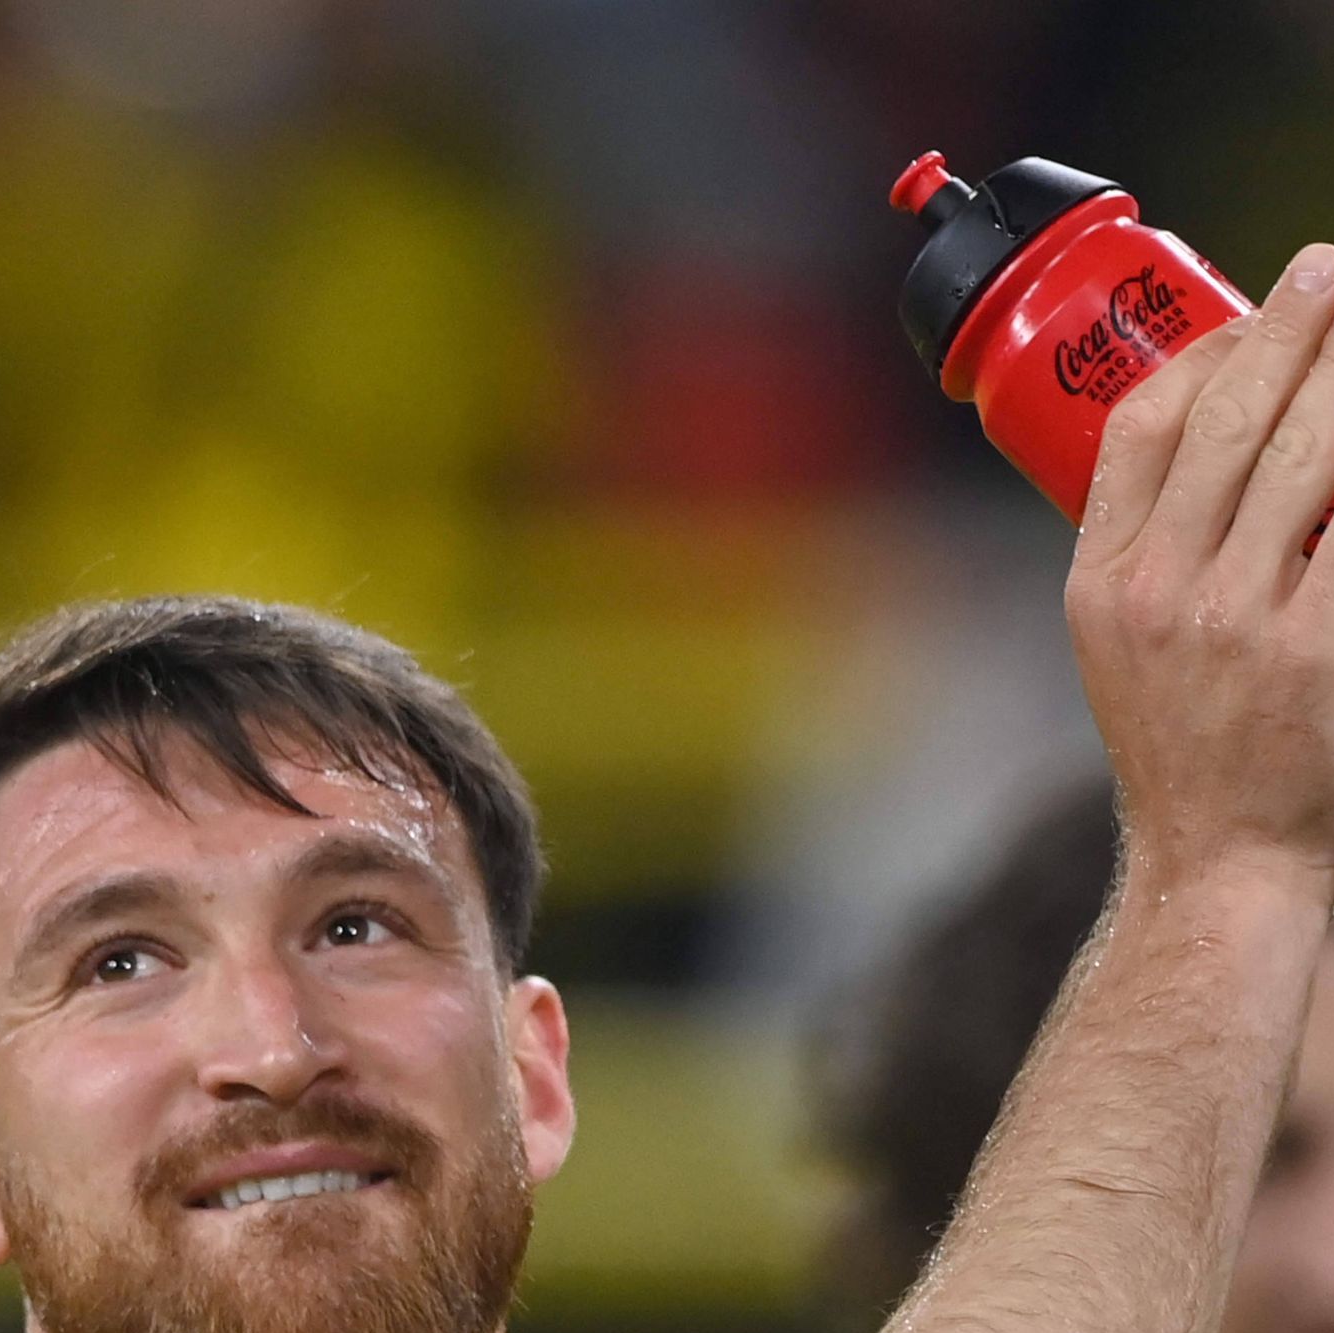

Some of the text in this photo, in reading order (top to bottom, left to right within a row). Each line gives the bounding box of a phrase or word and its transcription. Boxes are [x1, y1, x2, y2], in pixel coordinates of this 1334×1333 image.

[1087, 307, 1185, 401] ZERO SUGAR
[1100, 371, 1137, 406] NULL
